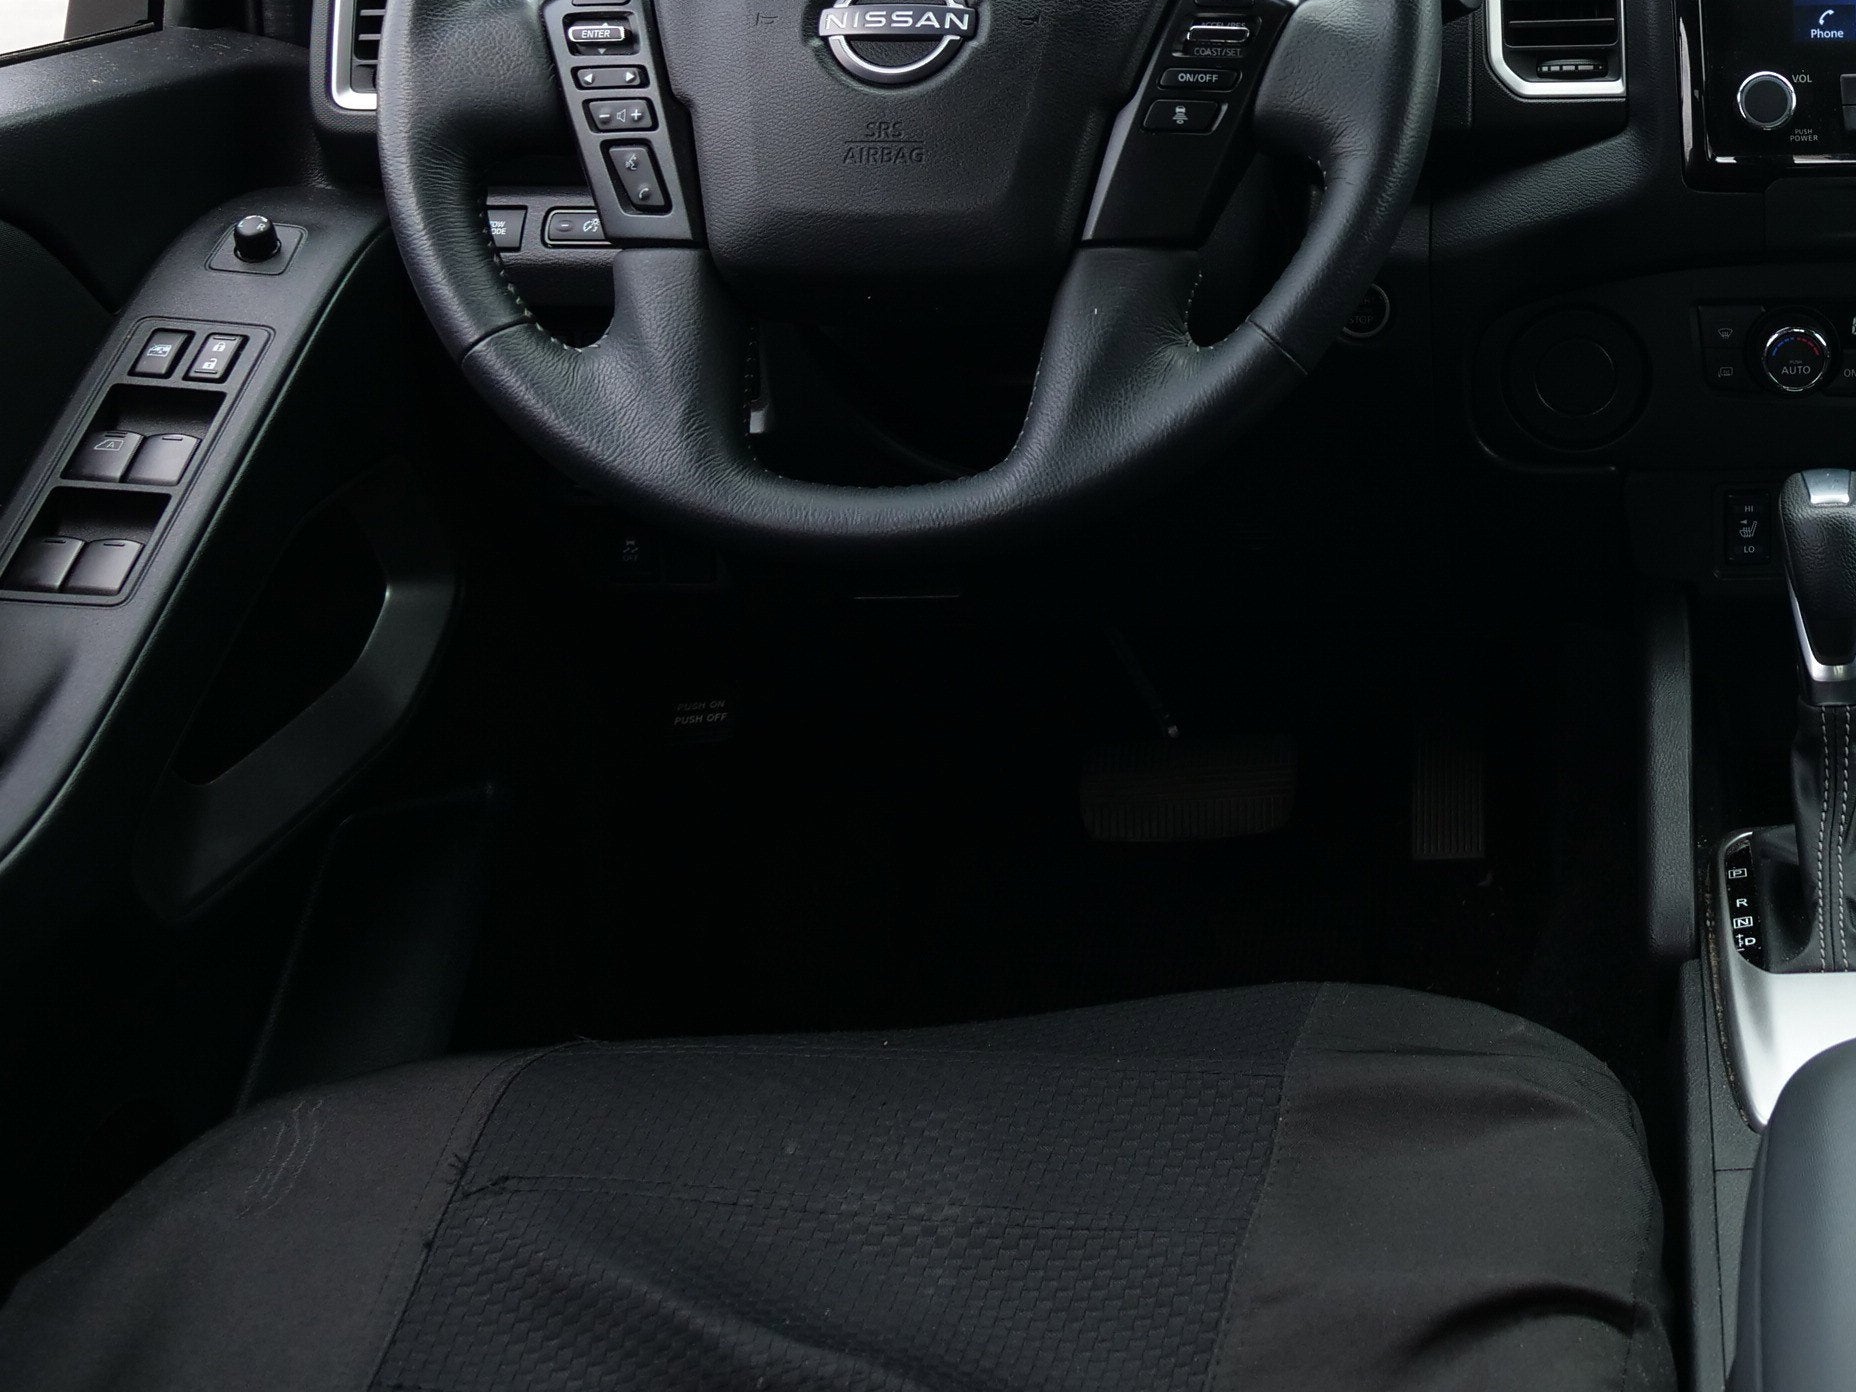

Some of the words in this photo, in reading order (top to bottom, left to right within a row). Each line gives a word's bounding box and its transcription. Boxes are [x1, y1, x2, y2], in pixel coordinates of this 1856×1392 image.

[826, 11, 970, 31] NISSAN
[580, 28, 611, 39] ENTER
[1810, 27, 1844, 39] Phone
[1193, 47, 1242, 56] COAST/SET
[1177, 72, 1219, 83] ON/OFF
[1791, 73, 1812, 83] VOL
[864, 121, 904, 139] SRS
[1790, 133, 1819, 143] POWER
[842, 146, 925, 165] AIRBAG
[1781, 364, 1811, 376] AUTO
[1743, 505, 1753, 513] HI
[1743, 545, 1755, 554] LO
[674, 714, 704, 725] PUSH
[706, 712, 729, 723] OFF
[1736, 898, 1749, 907] R
